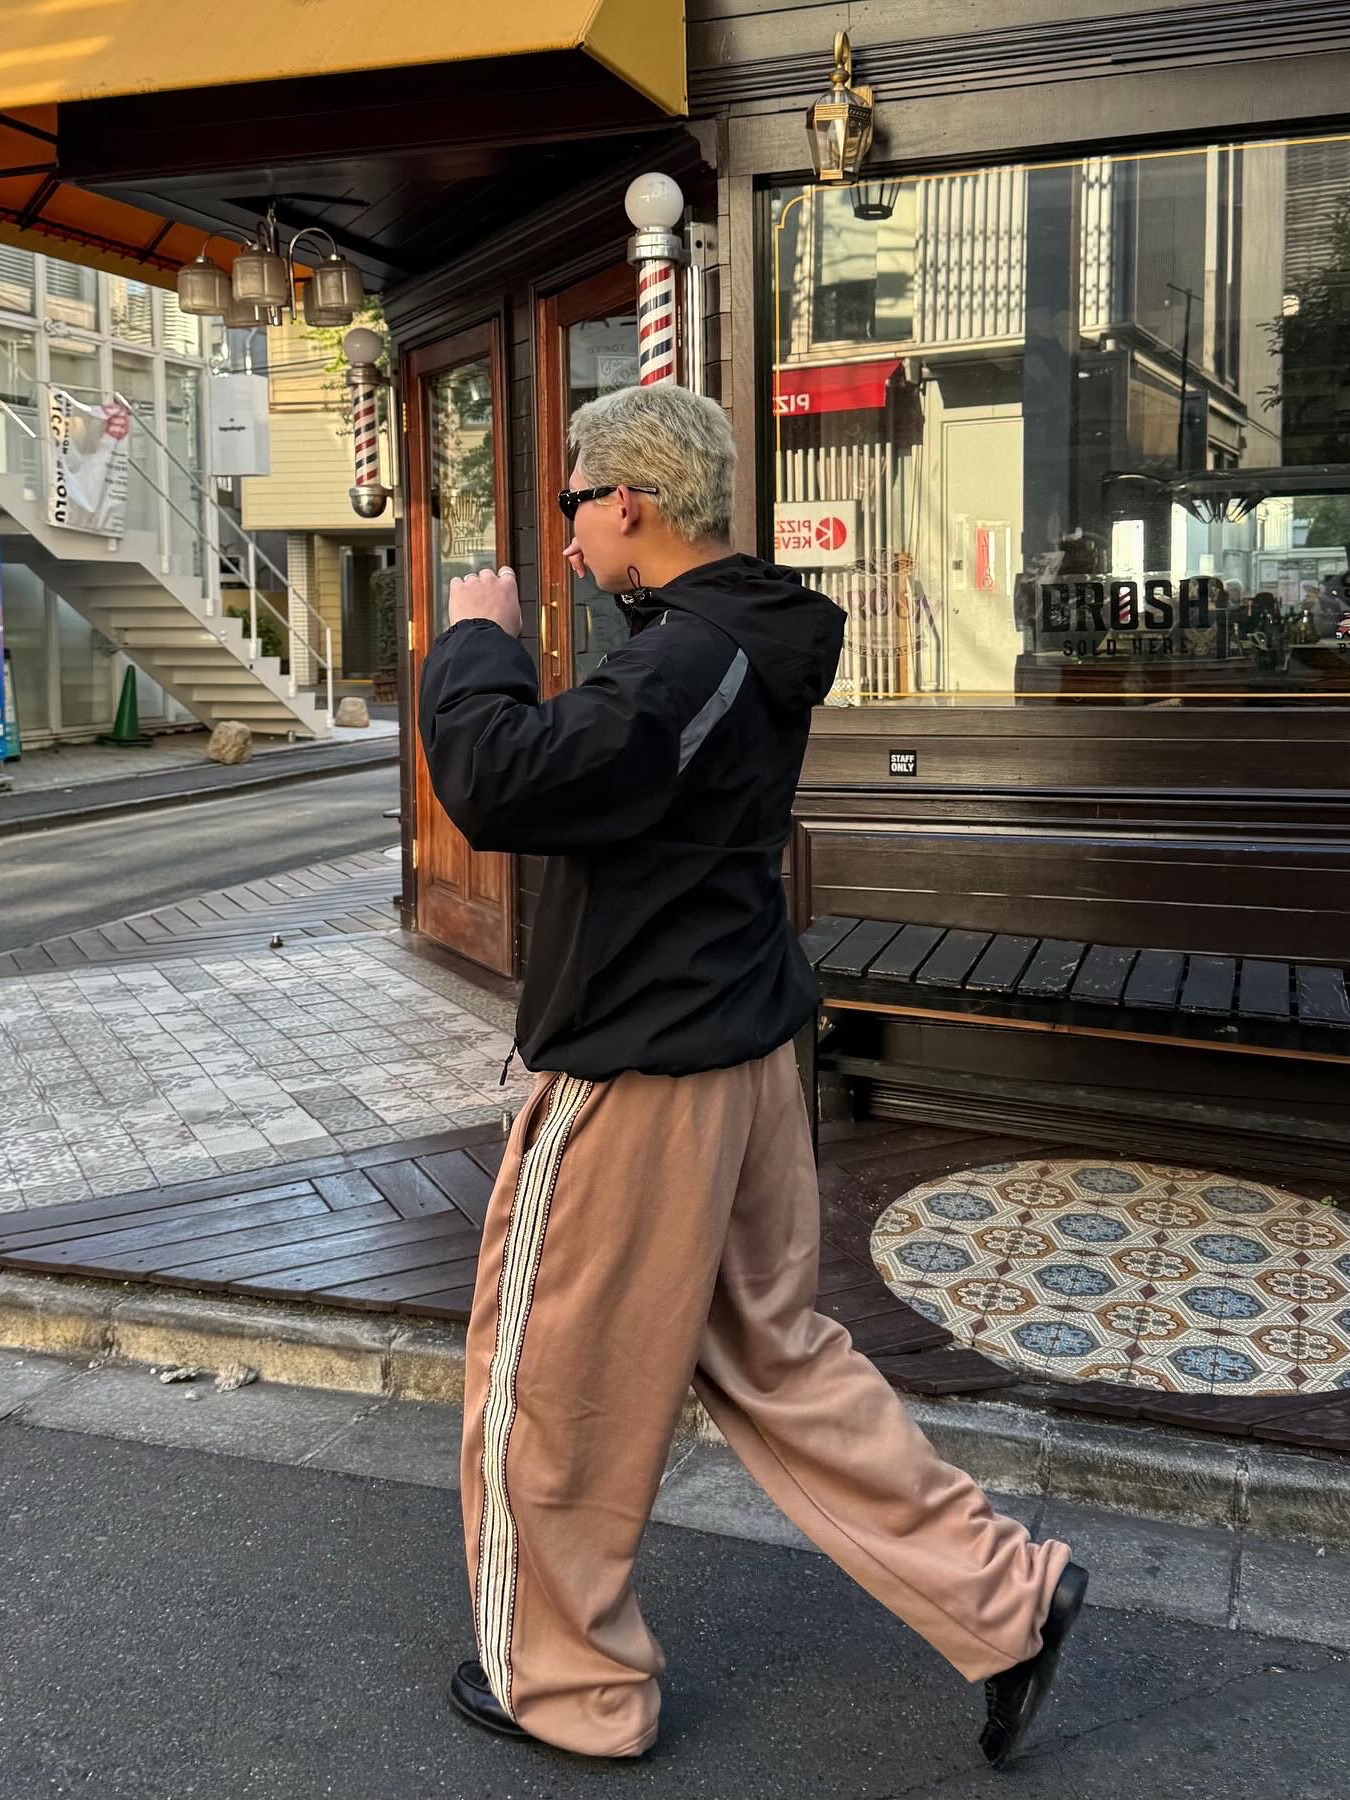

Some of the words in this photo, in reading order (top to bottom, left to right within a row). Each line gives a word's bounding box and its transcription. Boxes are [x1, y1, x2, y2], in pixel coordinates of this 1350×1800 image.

[1063, 639, 1117, 656] SOLD
[1133, 637, 1189, 656] HERE
[891, 754, 915, 763] STAFF
[891, 762, 915, 772] ONLY
